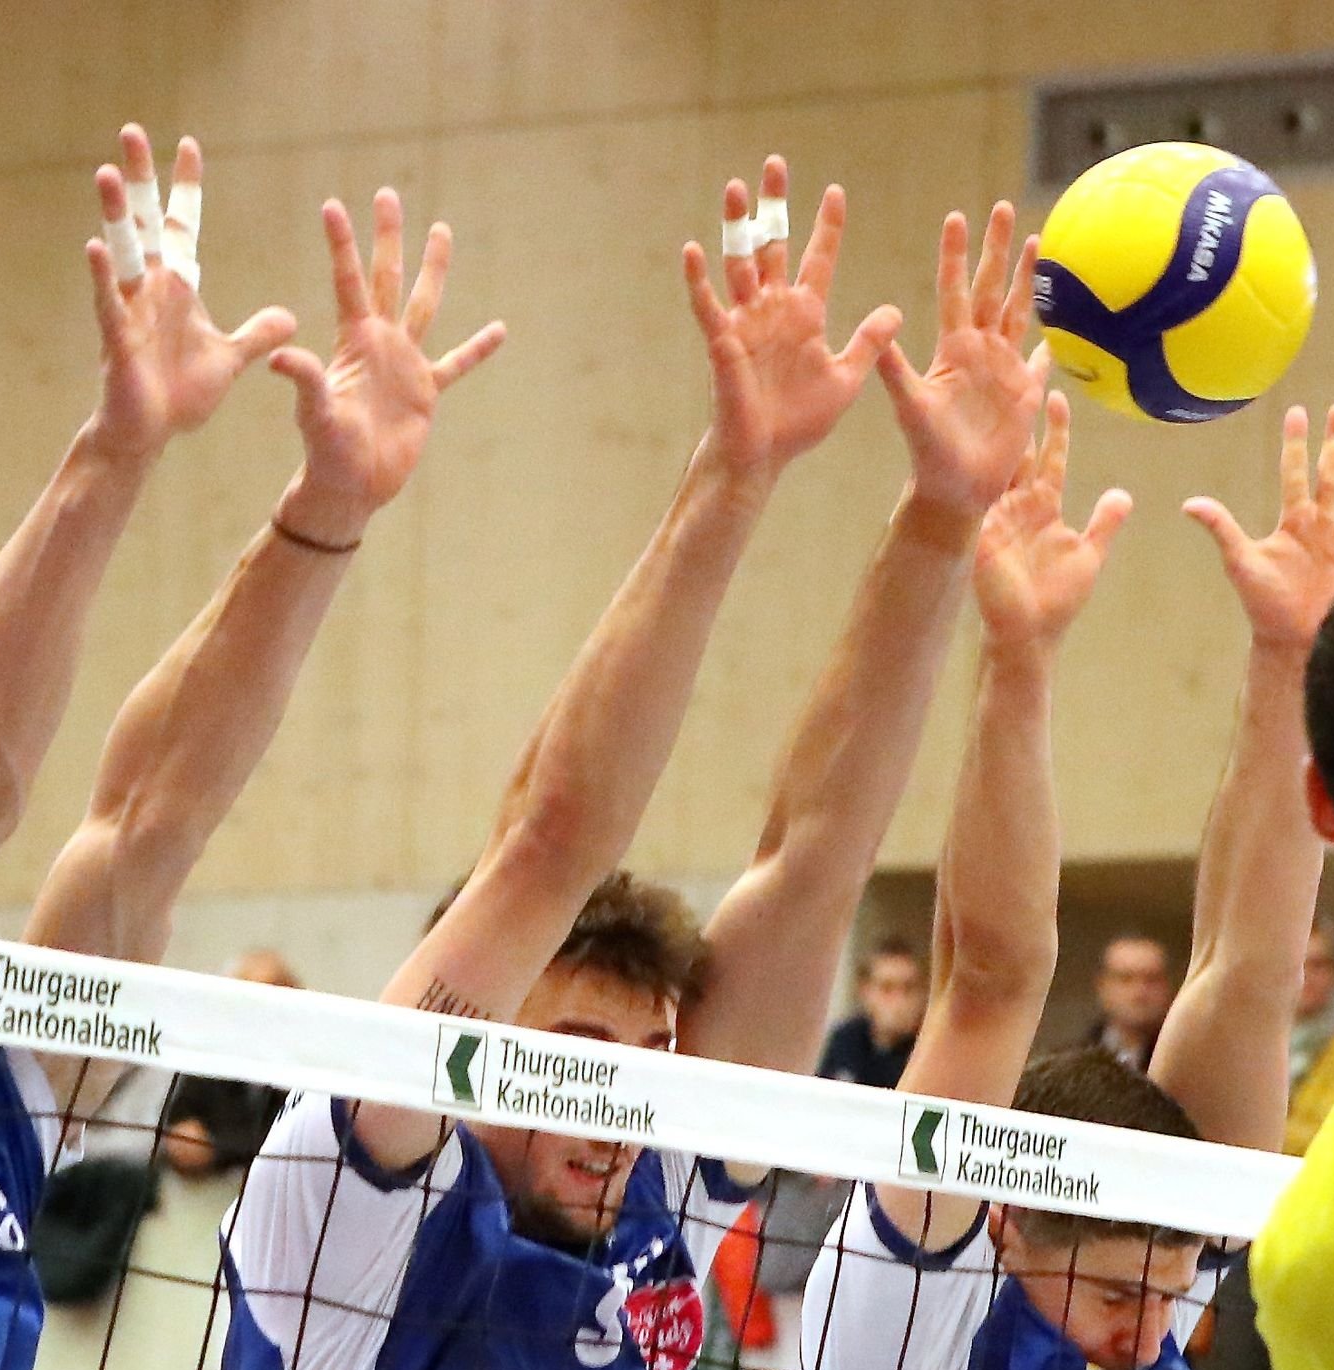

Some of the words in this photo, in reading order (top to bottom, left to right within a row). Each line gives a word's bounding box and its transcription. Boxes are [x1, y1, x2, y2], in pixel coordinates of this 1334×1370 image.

[499, 1037, 619, 1088] Thurgauer
[496, 1077, 656, 1134] Kantonalbank
[959, 1113, 1067, 1161] Thurgauer
[956, 1151, 1101, 1204] Kantonalbank
